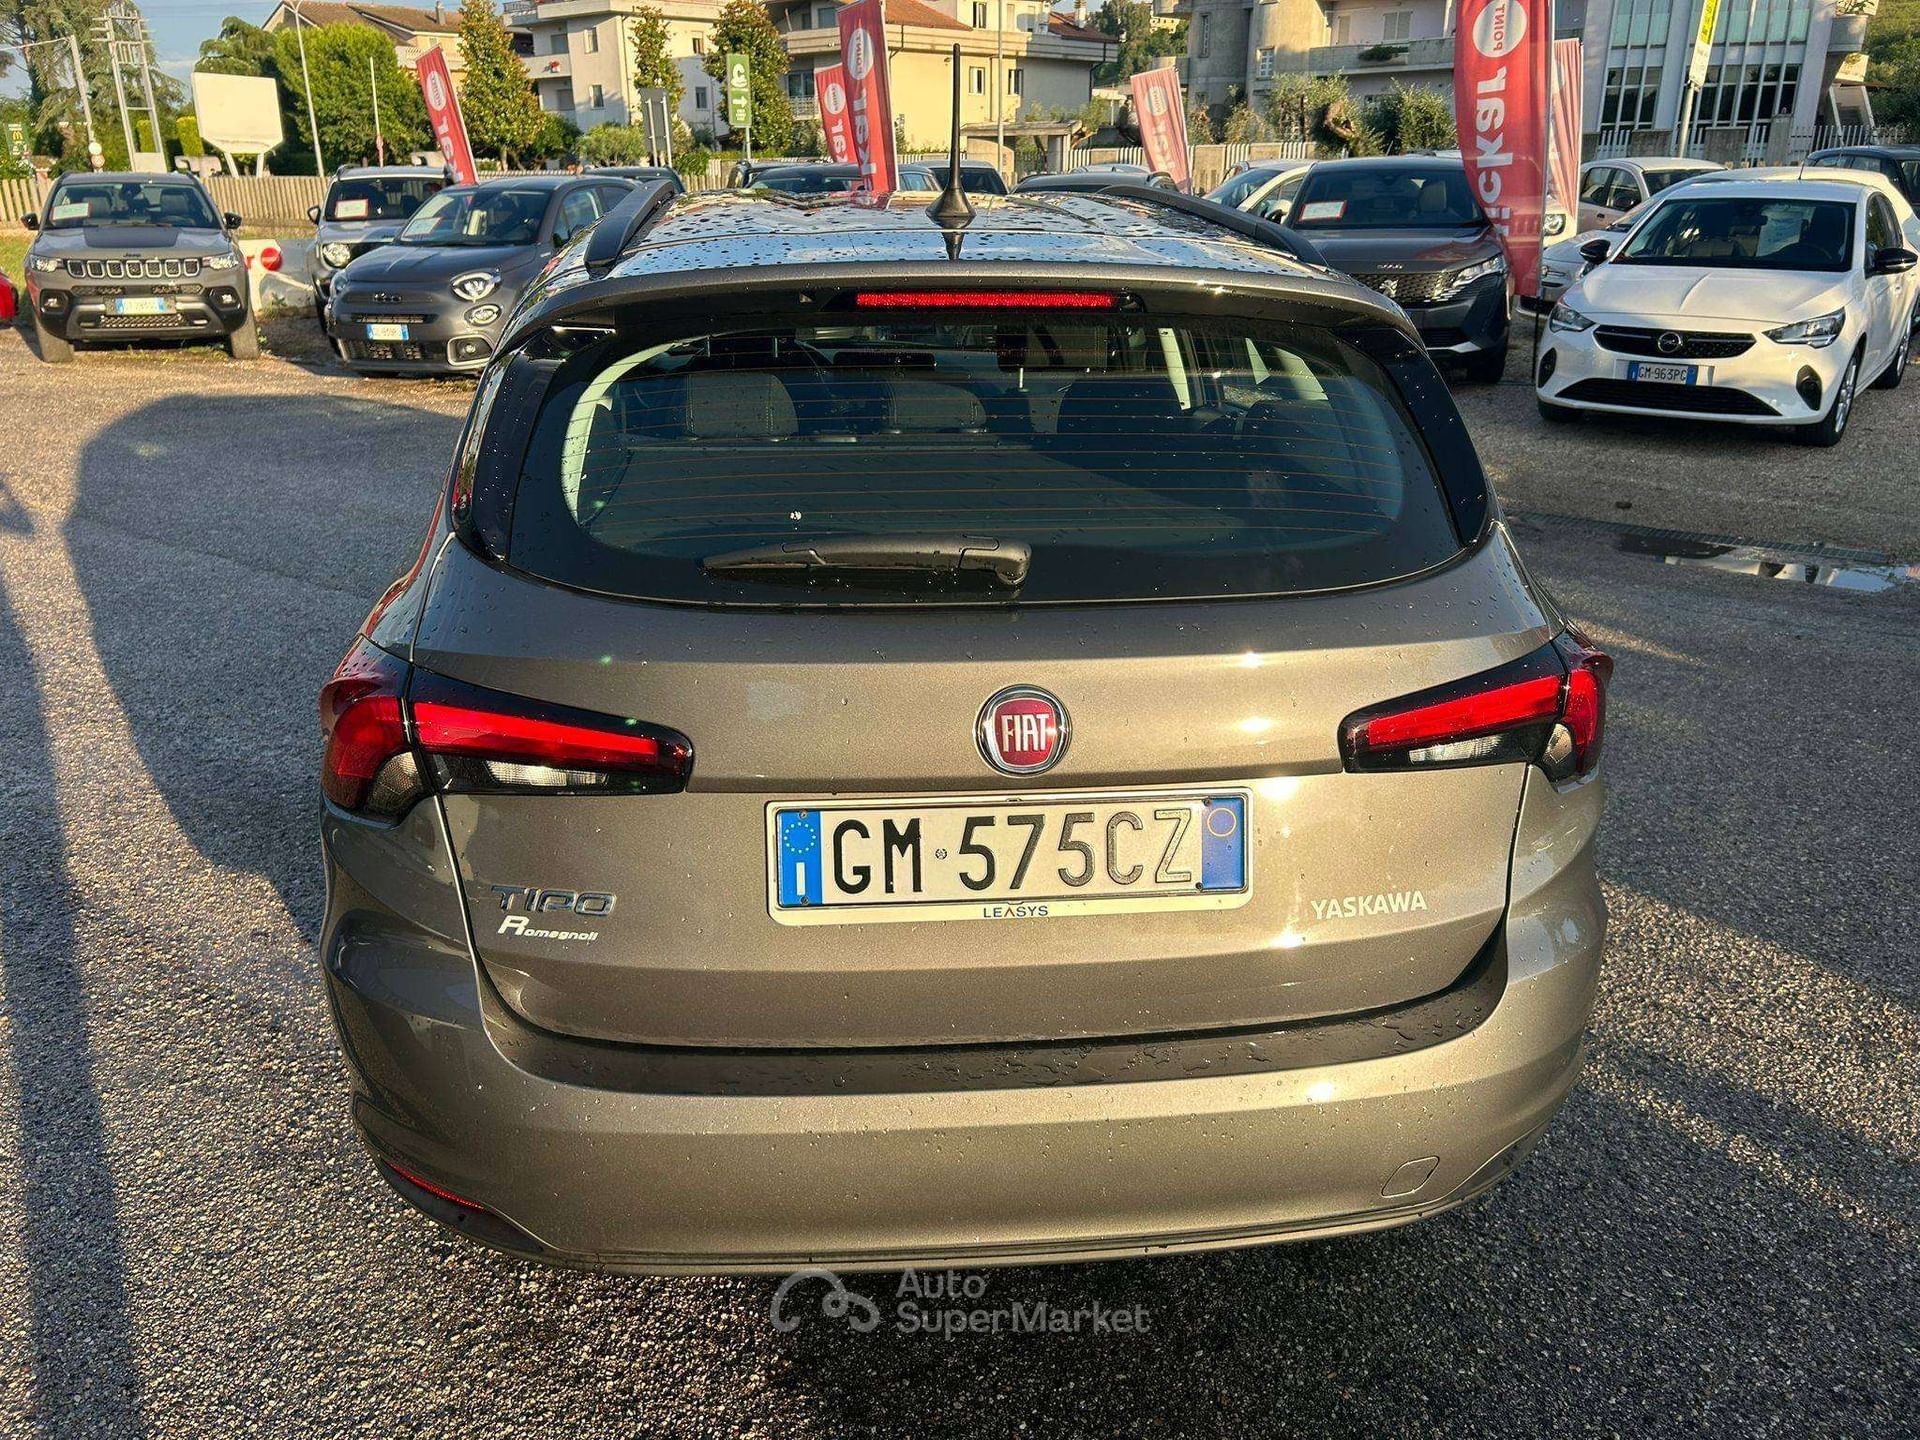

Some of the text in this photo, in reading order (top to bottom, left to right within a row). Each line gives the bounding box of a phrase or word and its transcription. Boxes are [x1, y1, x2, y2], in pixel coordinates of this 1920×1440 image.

[1001, 713, 1050, 752] FIAT
[833, 818, 923, 894] GM
[959, 808, 1192, 891] 575CZ
[490, 884, 617, 916] TIPO
[983, 906, 1049, 918] LEASYS
[1310, 890, 1428, 920] YASKAWA
[497, 915, 599, 940] Romagnoli
